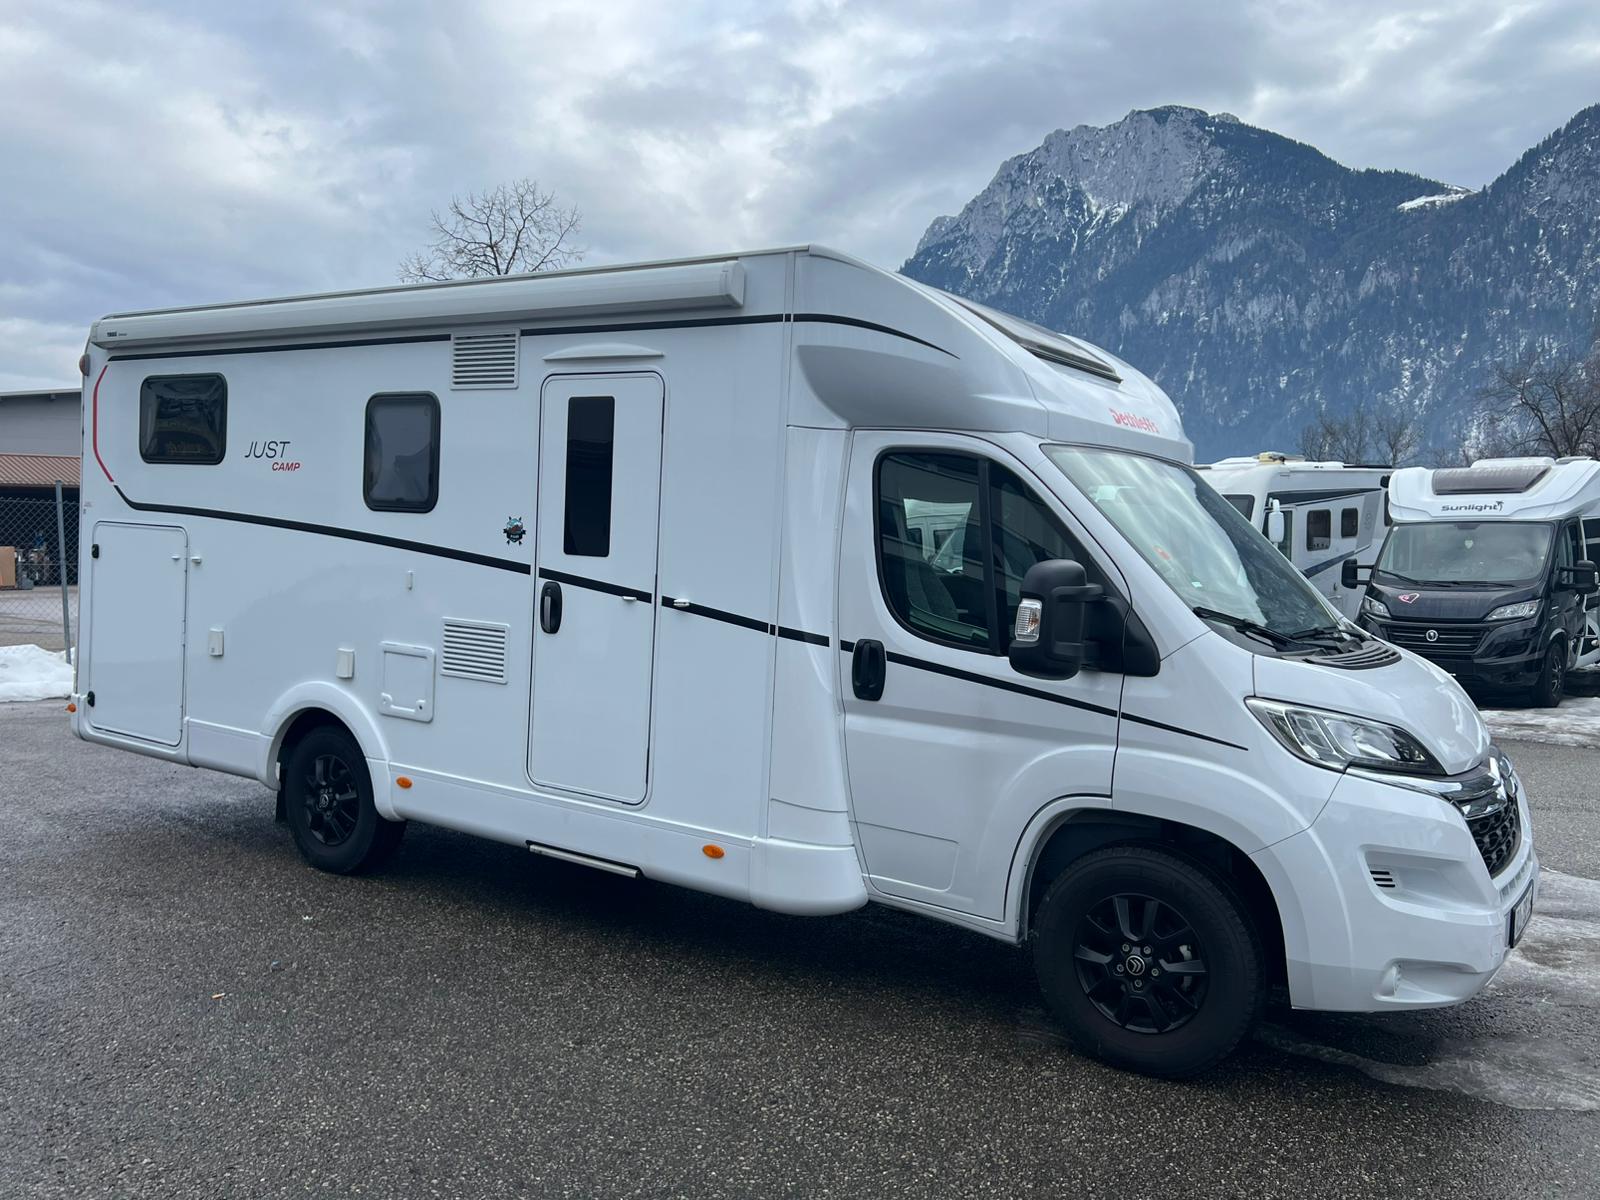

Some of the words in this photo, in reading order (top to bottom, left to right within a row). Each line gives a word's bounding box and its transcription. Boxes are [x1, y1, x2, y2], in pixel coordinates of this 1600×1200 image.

[244, 440, 291, 459] JUST
[271, 461, 301, 472] CAMP
[1441, 503, 1499, 512] Sunlight
